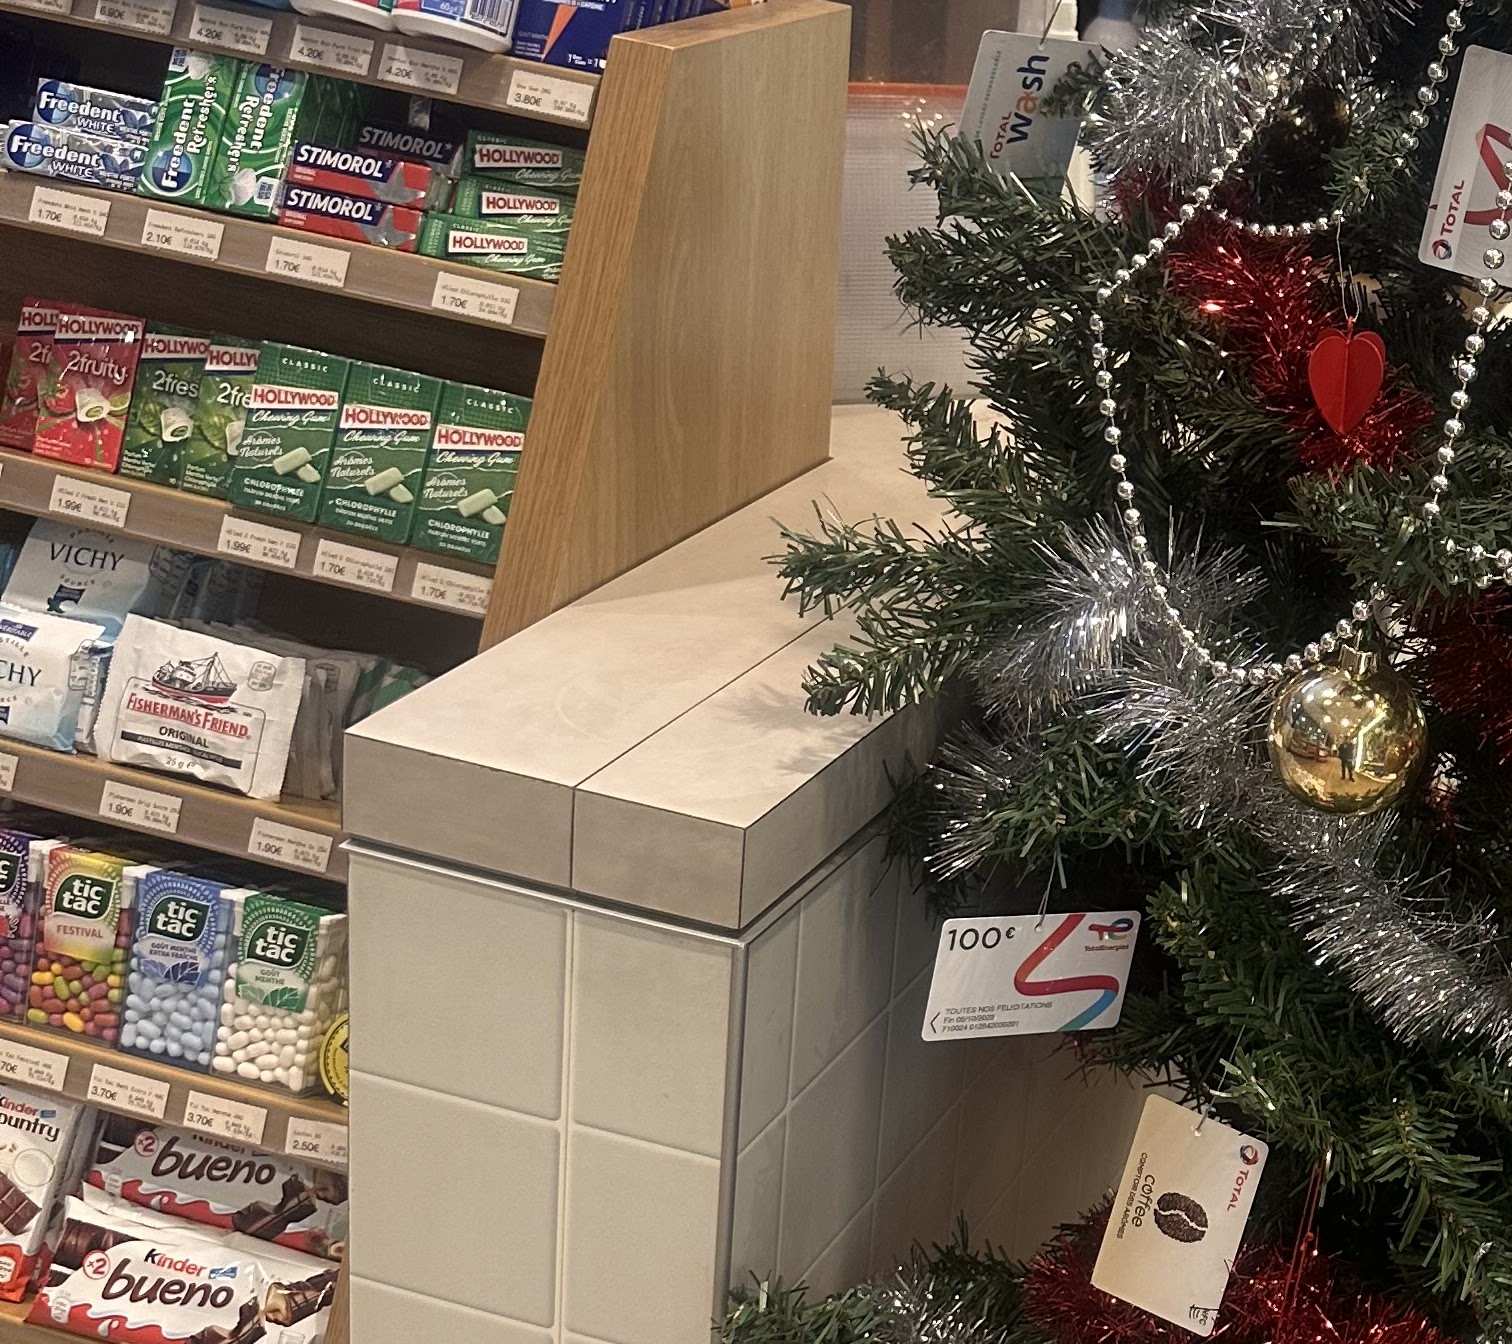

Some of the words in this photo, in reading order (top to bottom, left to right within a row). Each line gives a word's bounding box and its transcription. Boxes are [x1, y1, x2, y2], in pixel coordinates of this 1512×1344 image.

[39, 92, 121, 123] Freedent
[514, 92, 543, 107] 3.80€
[1006, 54, 1050, 145] wash
[187, 75, 218, 155] Refreshers
[250, 66, 285, 155] Freedent
[76, 117, 116, 134] WHITE
[161, 98, 195, 189] Freedent
[359, 126, 444, 159] STIMOROL
[990, 111, 1011, 160] TOTAL
[11, 134, 101, 168] Freedent
[478, 148, 560, 165] HOLLYWOOD
[52, 160, 94, 177] WHITE
[297, 144, 384, 179] STIMOROL
[287, 188, 373, 221] STIMOROL
[485, 196, 558, 212] HOLLYWOOD
[1441, 180, 1465, 237] TOTAL
[37, 209, 62, 224] 1.70€
[146, 231, 173, 245] 2.10€
[452, 235, 525, 251] HOLLYWOOD
[275, 259, 301, 274] 1.70€
[441, 295, 468, 310] 1.70€
[58, 318, 141, 336] HOLLYWOOD
[67, 350, 128, 385] 2fruity
[282, 358, 328, 373] CLASSIC
[373, 376, 421, 393] CLASSIC
[253, 387, 335, 406] HOLLYWOOD
[467, 398, 513, 414] CLASSIC
[252, 411, 300, 424] Chewing
[302, 413, 331, 424] Gum
[344, 408, 428, 426] HOLLYWOOD
[343, 431, 391, 443] Chewing
[393, 433, 421, 443] Gum
[437, 429, 522, 447] HOLLYWOOD
[436, 452, 485, 464] Chewing
[486, 454, 514, 464] Gum
[335, 498, 397, 518] CHLOROPHYLLE
[428, 519, 491, 539] CHLOROPHYLLE
[50, 542, 125, 571] VICHY
[226, 540, 251, 554] 1.99€
[320, 561, 346, 576] 1.70€
[421, 585, 447, 600] 1.70€
[128, 693, 202, 729] FISHERMAN'S
[202, 713, 251, 739] FRIEND
[159, 726, 209, 748] ORIGINAL
[108, 802, 133, 817] 1.90€
[257, 841, 282, 856] 1.90€
[73, 879, 104, 900] tic
[63, 891, 100, 914] tac
[168, 901, 199, 923] tic
[57, 925, 103, 938] FESTIVAL
[156, 913, 196, 937] tac
[267, 926, 298, 948] tic
[255, 938, 295, 963] tac
[90, 1085, 118, 1101] 3.70€
[187, 1112, 215, 1128] 3.70€
[293, 1138, 320, 1153] 2.50€
[152, 1136, 276, 1185] bueno
[1131, 1152, 1148, 1193] COMPTOIR
[1226, 1169, 1249, 1212] TOTAL
[1131, 1174, 1156, 1229] coffee
[102, 1257, 235, 1308] bueno
